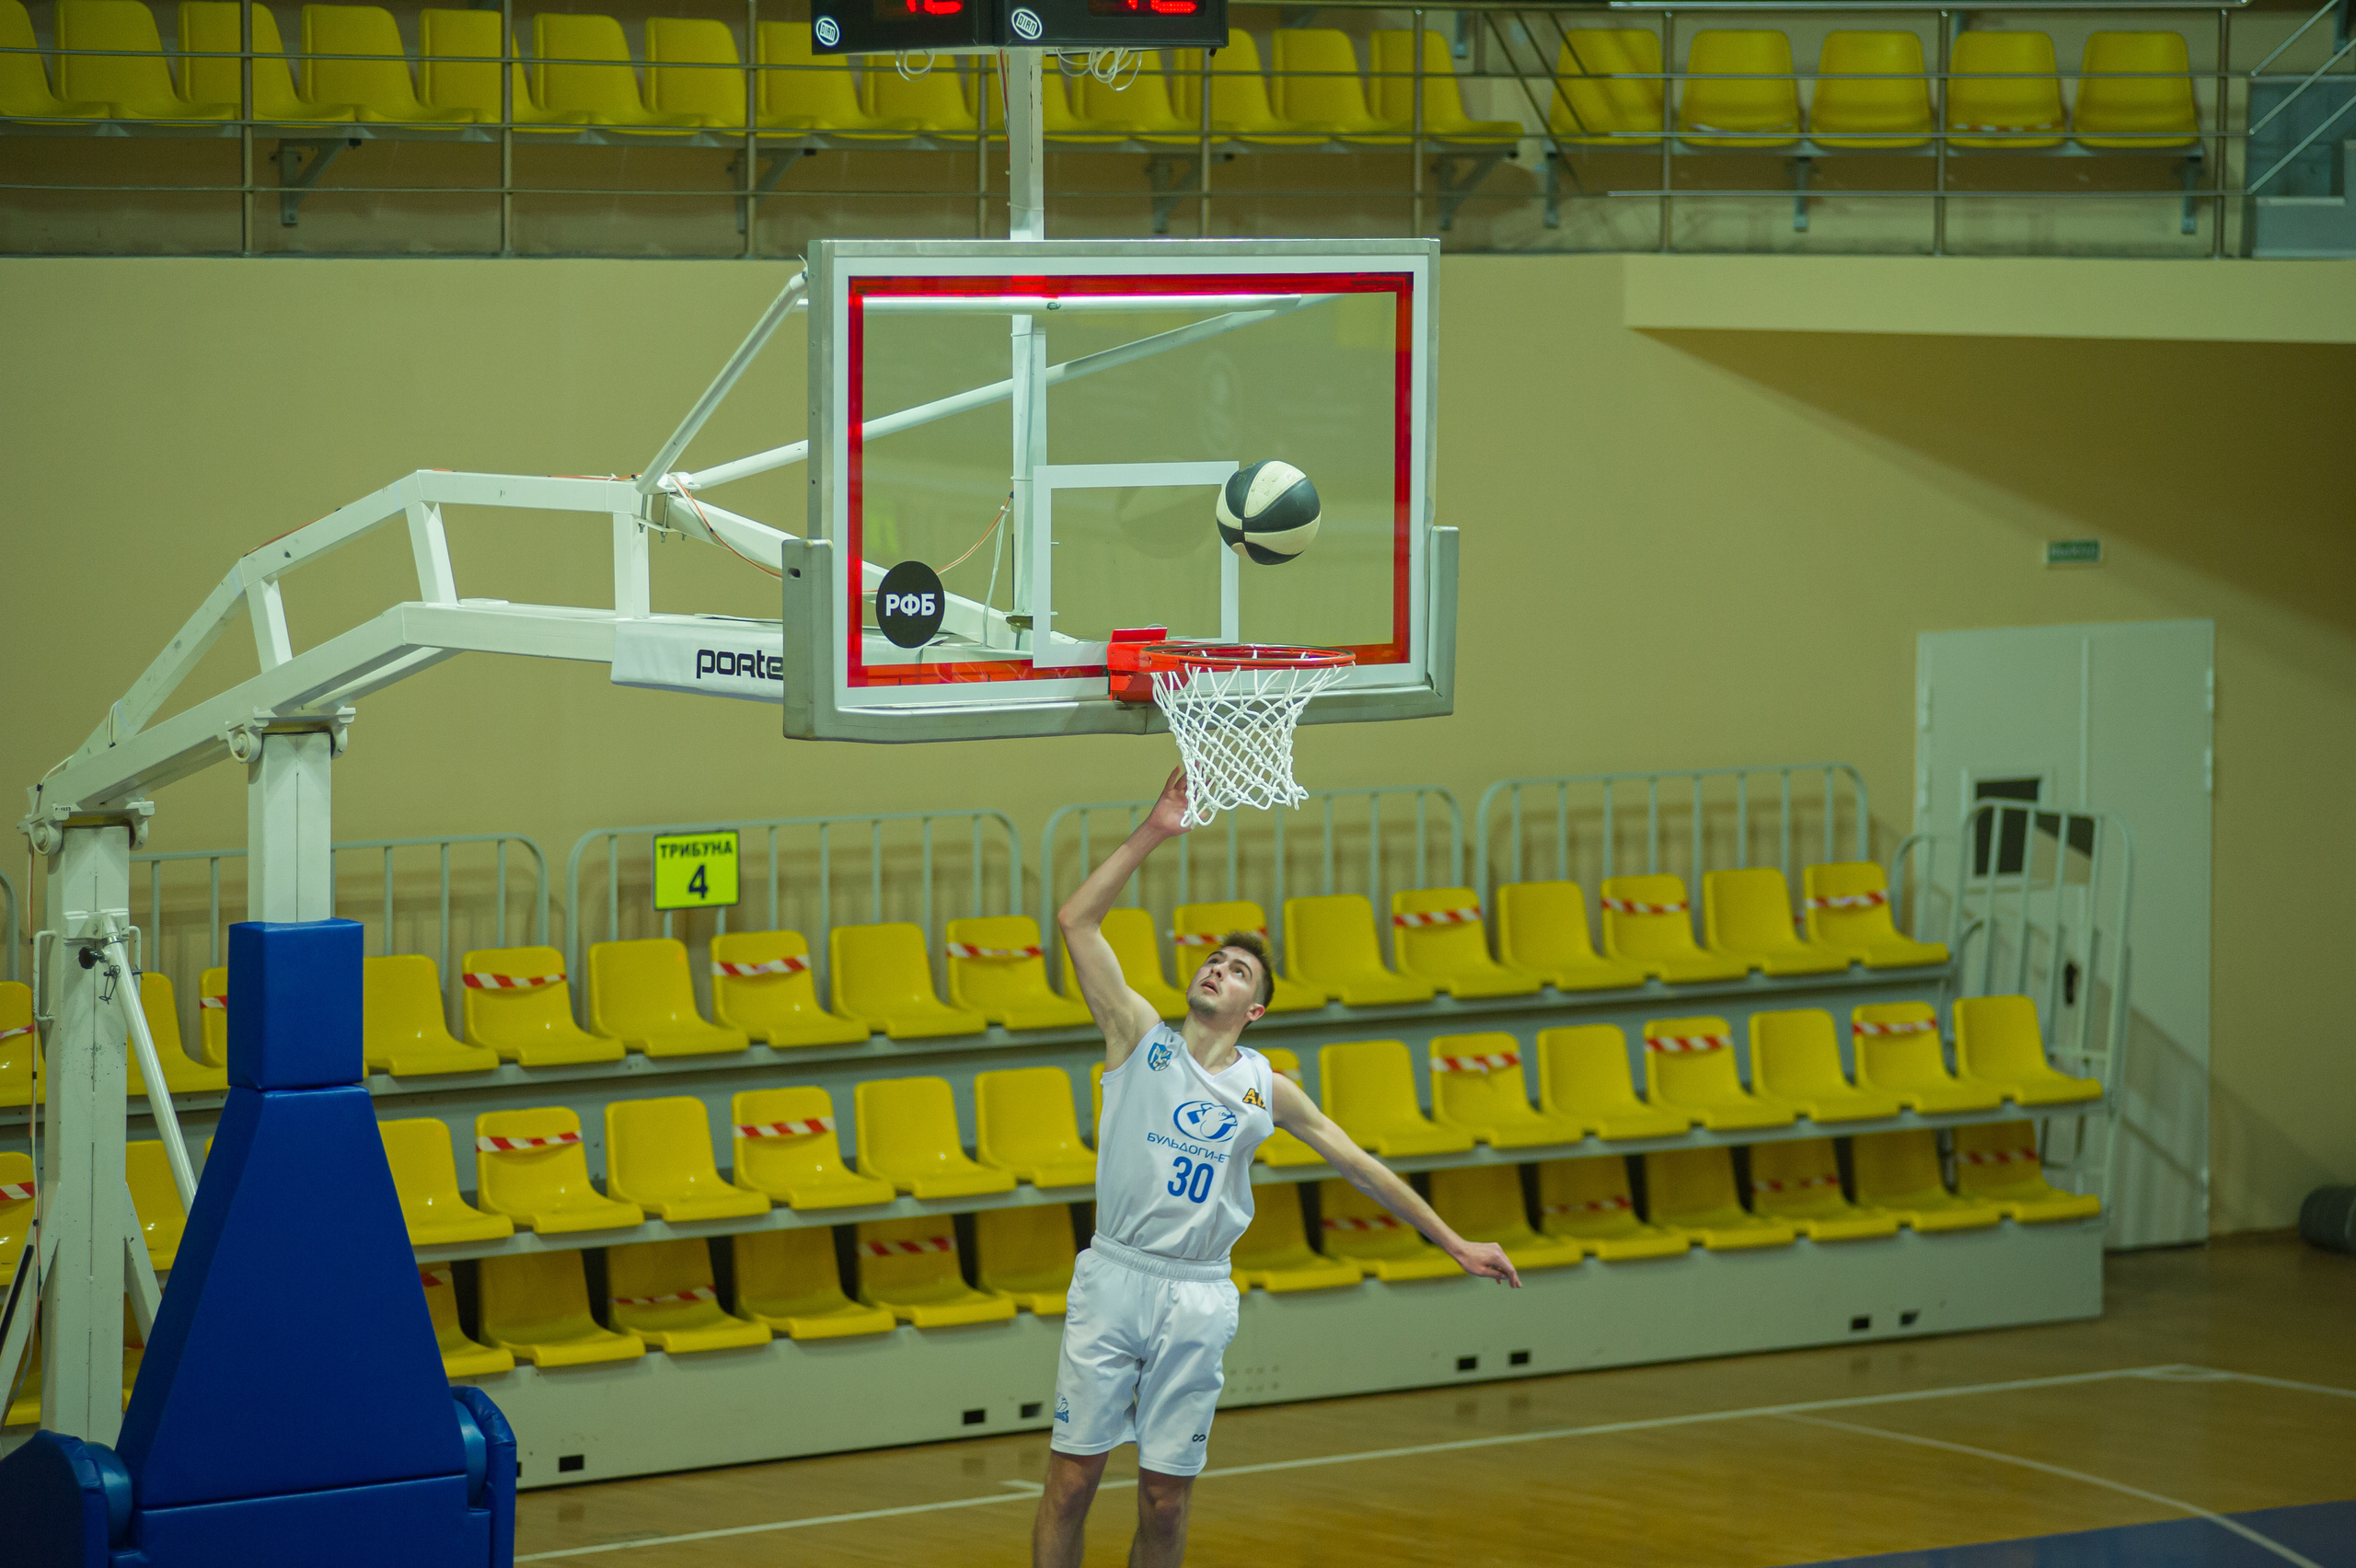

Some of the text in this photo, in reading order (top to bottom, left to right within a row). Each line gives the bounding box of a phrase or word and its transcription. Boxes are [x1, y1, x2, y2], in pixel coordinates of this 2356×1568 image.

[885, 593, 936, 617] РФБ
[660, 841, 733, 859] ТРИБУНА
[688, 864, 709, 900] 4
[1147, 1132, 1230, 1163] БУЛЬДОГИ-Е
[1167, 1156, 1215, 1205] 30
